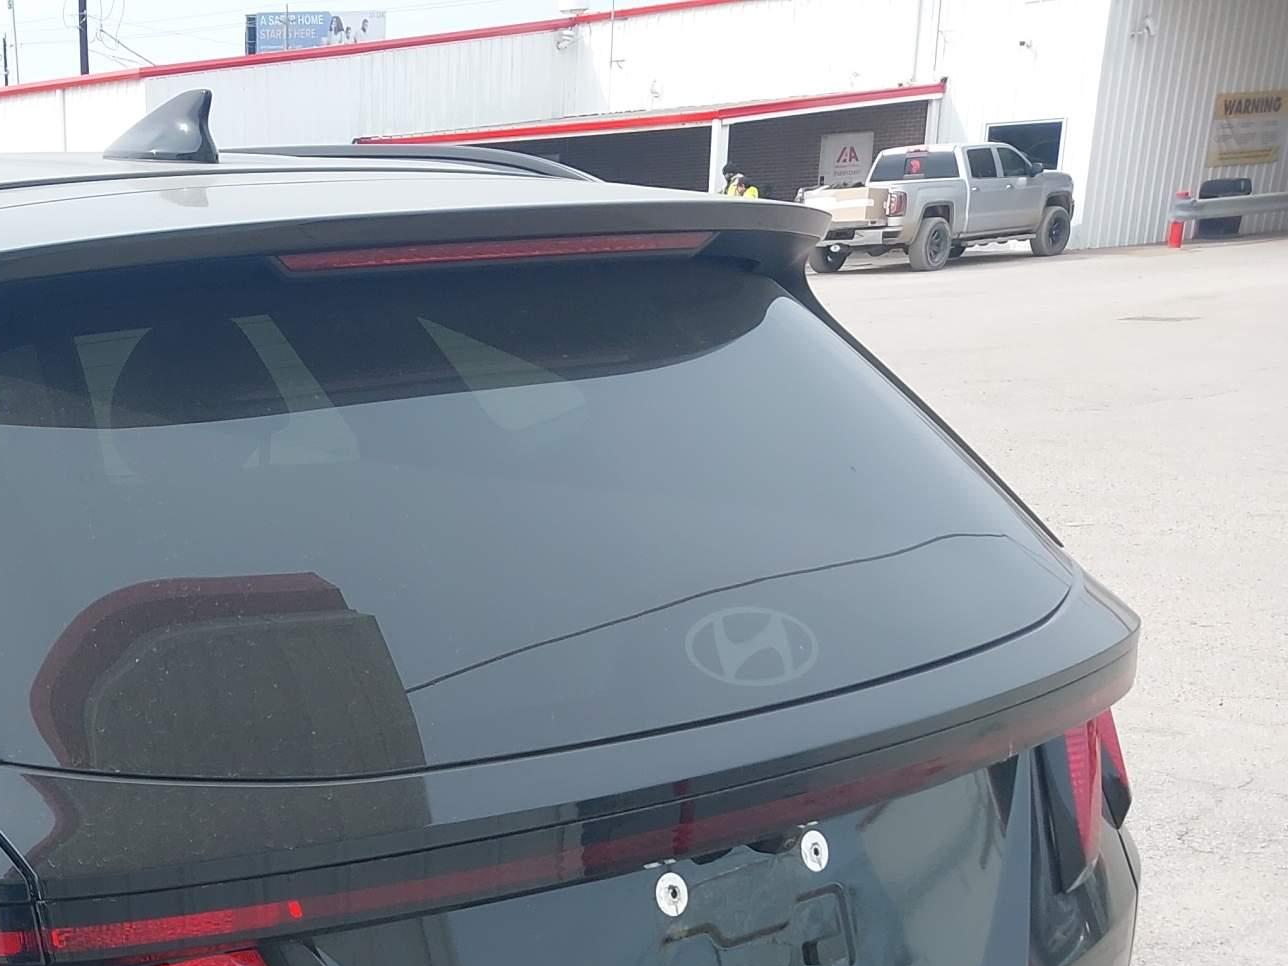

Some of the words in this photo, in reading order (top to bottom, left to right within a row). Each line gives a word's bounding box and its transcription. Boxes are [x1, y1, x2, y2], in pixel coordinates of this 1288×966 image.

[260, 15, 267, 25] A
[268, 15, 296, 25] SAFR
[298, 14, 324, 25] HOME
[1224, 96, 1283, 115] WARNING
